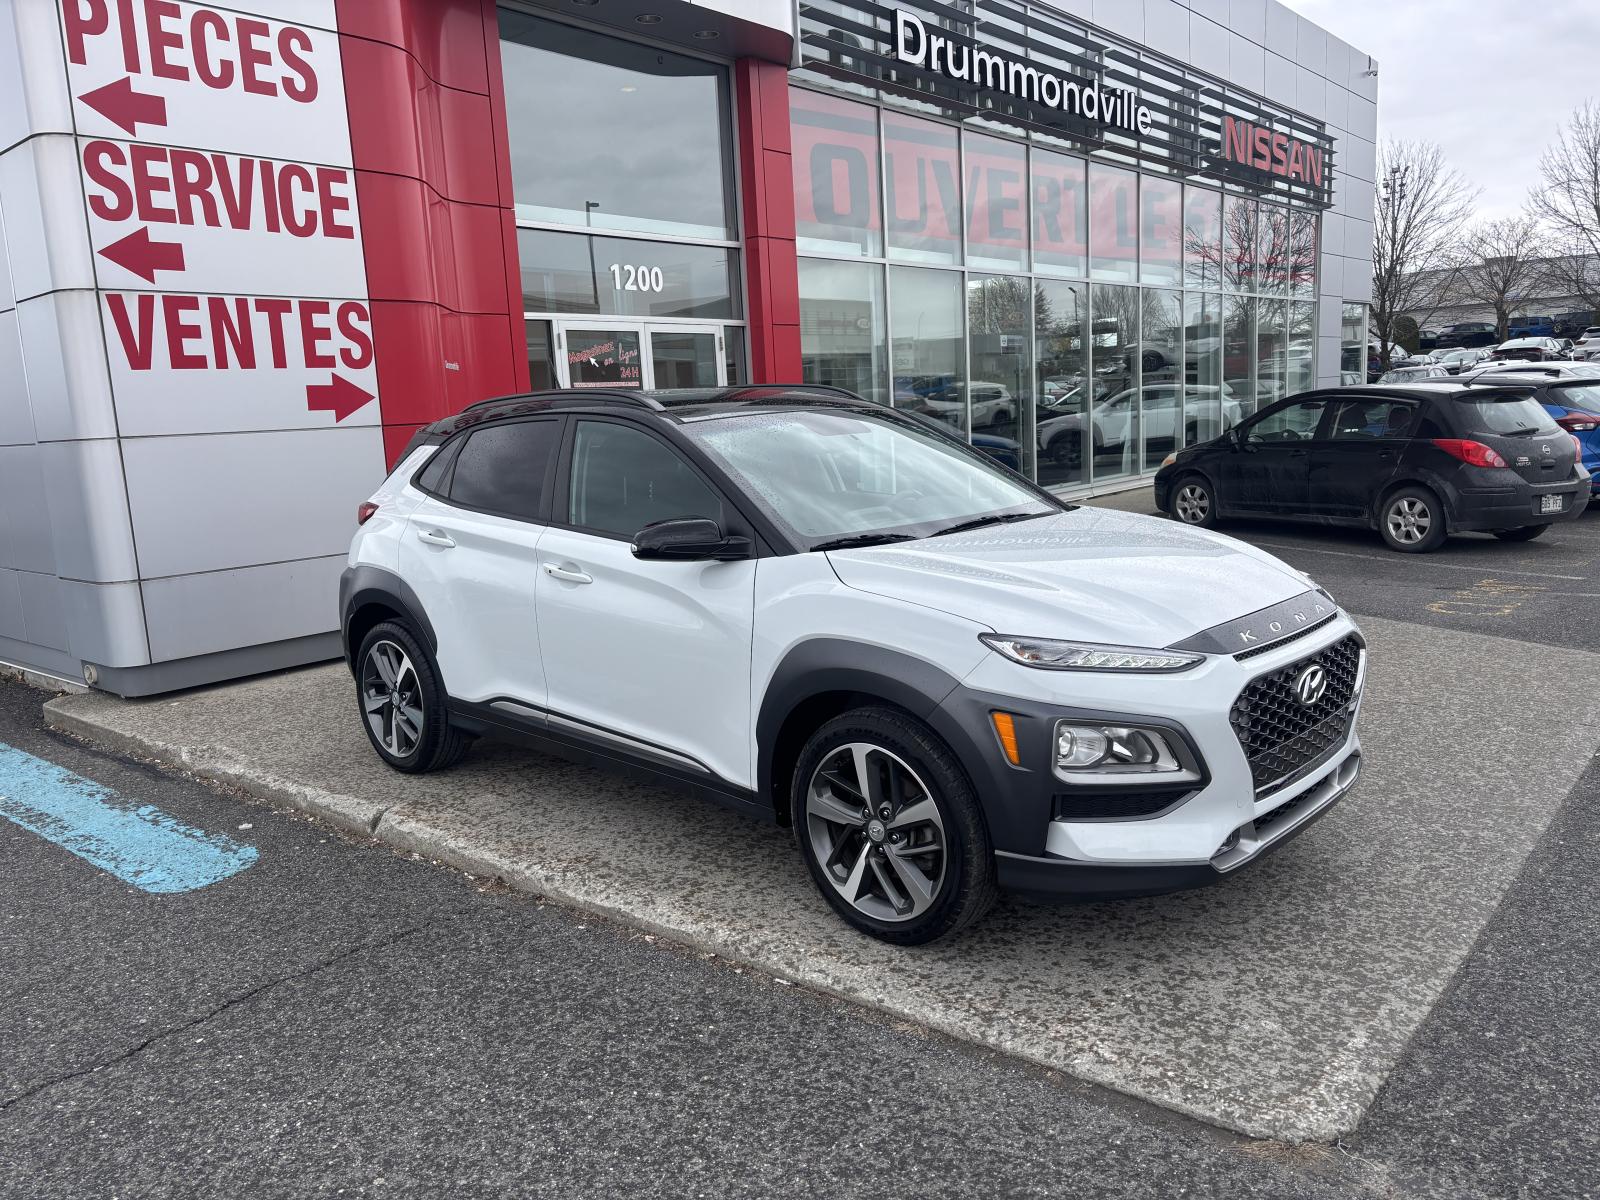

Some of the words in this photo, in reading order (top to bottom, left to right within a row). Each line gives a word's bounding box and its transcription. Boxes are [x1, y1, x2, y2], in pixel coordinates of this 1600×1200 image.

[62, 0, 319, 104] PIECES
[894, 9, 1153, 136] Drummondville
[82, 140, 355, 240] SERVICE
[810, 143, 1096, 246] OUVERT
[1222, 116, 1323, 187] NISSAN
[609, 262, 664, 293] 1200
[105, 293, 374, 371] VENTES
[1239, 603, 1325, 643] KONA
